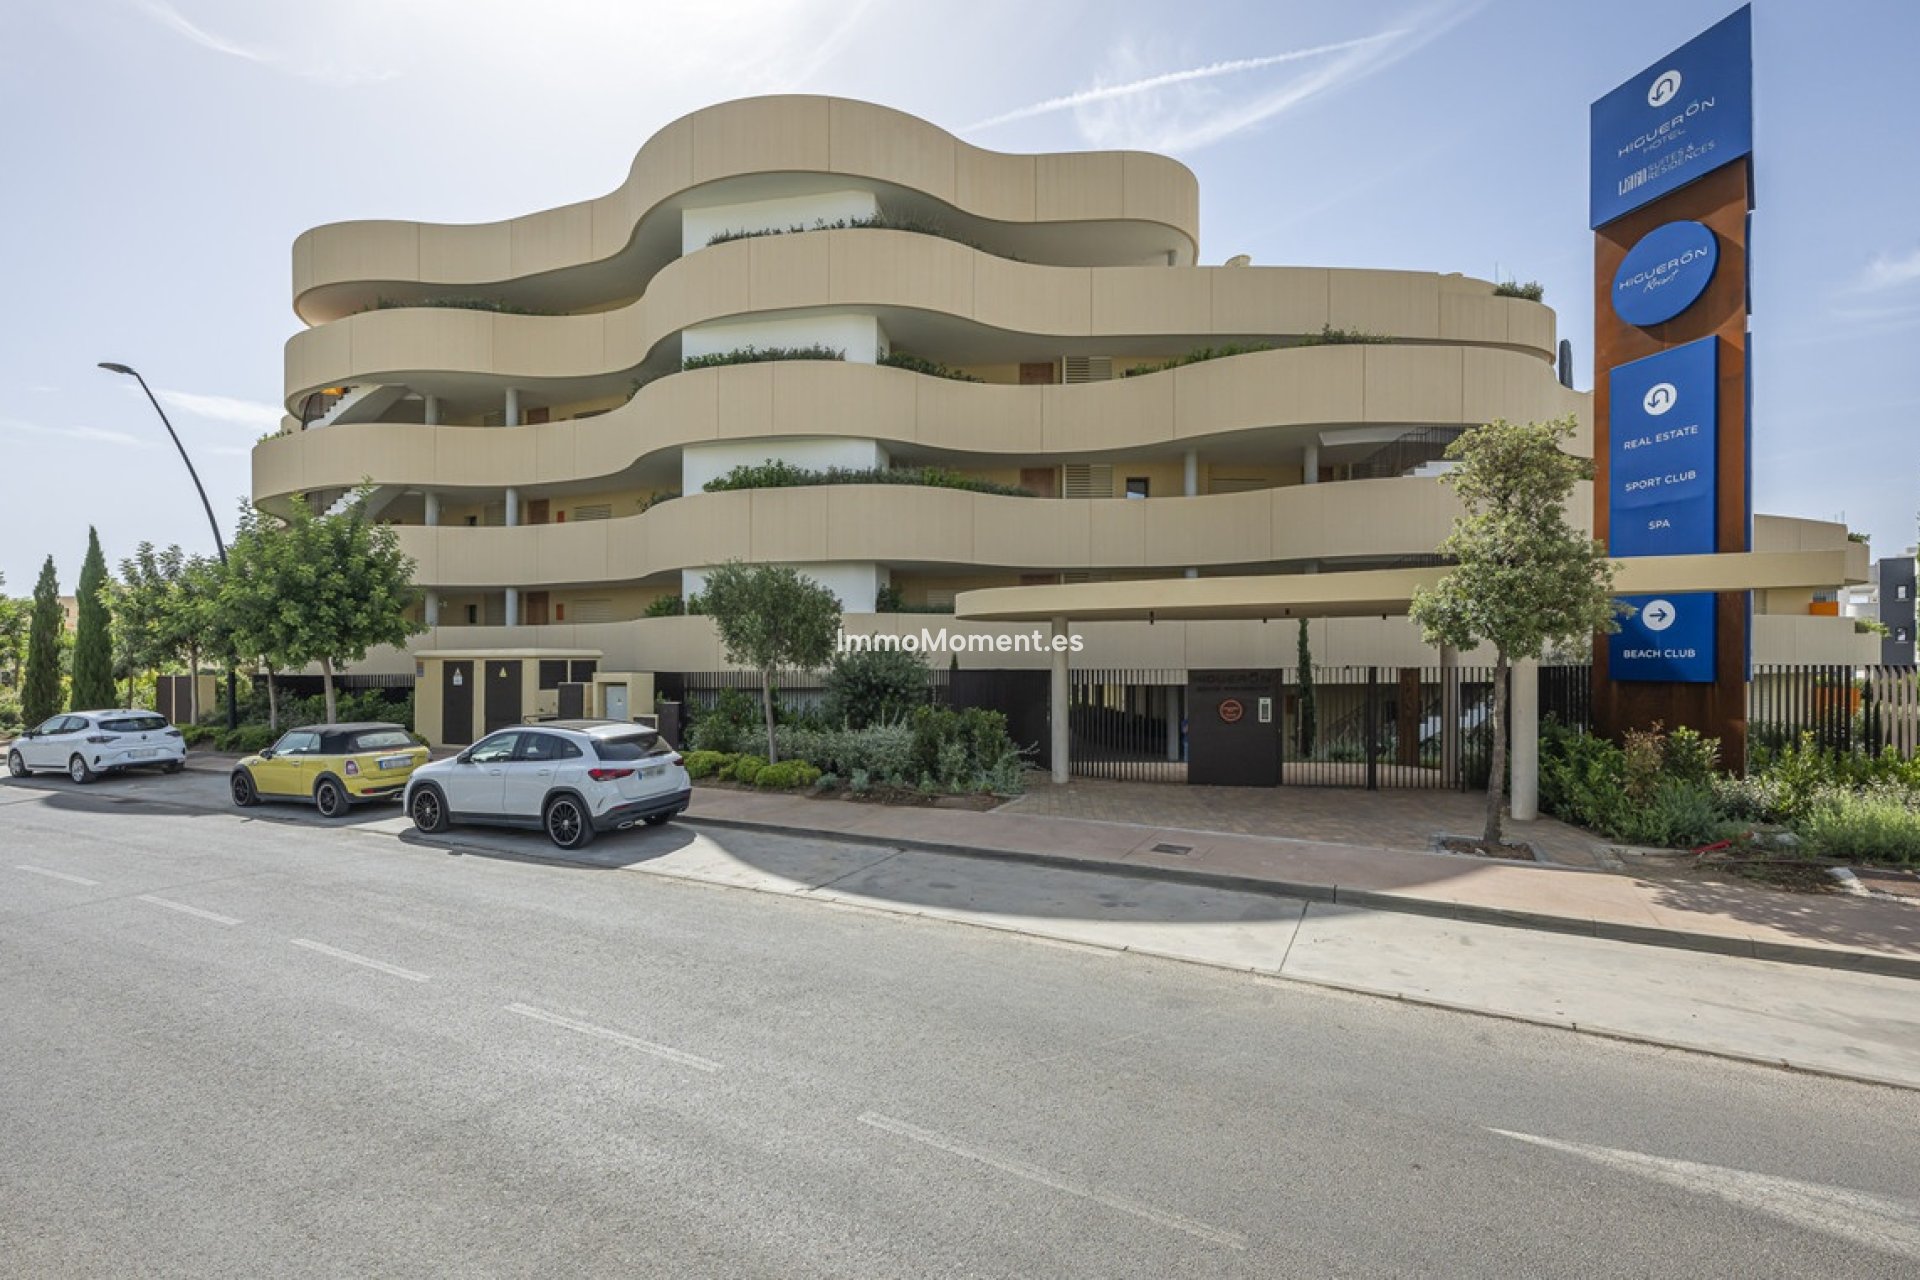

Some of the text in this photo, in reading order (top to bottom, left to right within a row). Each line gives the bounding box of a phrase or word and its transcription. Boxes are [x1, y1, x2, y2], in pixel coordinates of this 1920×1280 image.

[1643, 129, 1687, 153] HOTEL
[1648, 140, 1715, 180] RESIDENCES
[1624, 425, 1698, 450] REAL ESTATE
[1625, 470, 1696, 491] SPORT CLUB
[1648, 519, 1670, 529] SPA
[1623, 648, 1696, 659] BEACH CLUB
